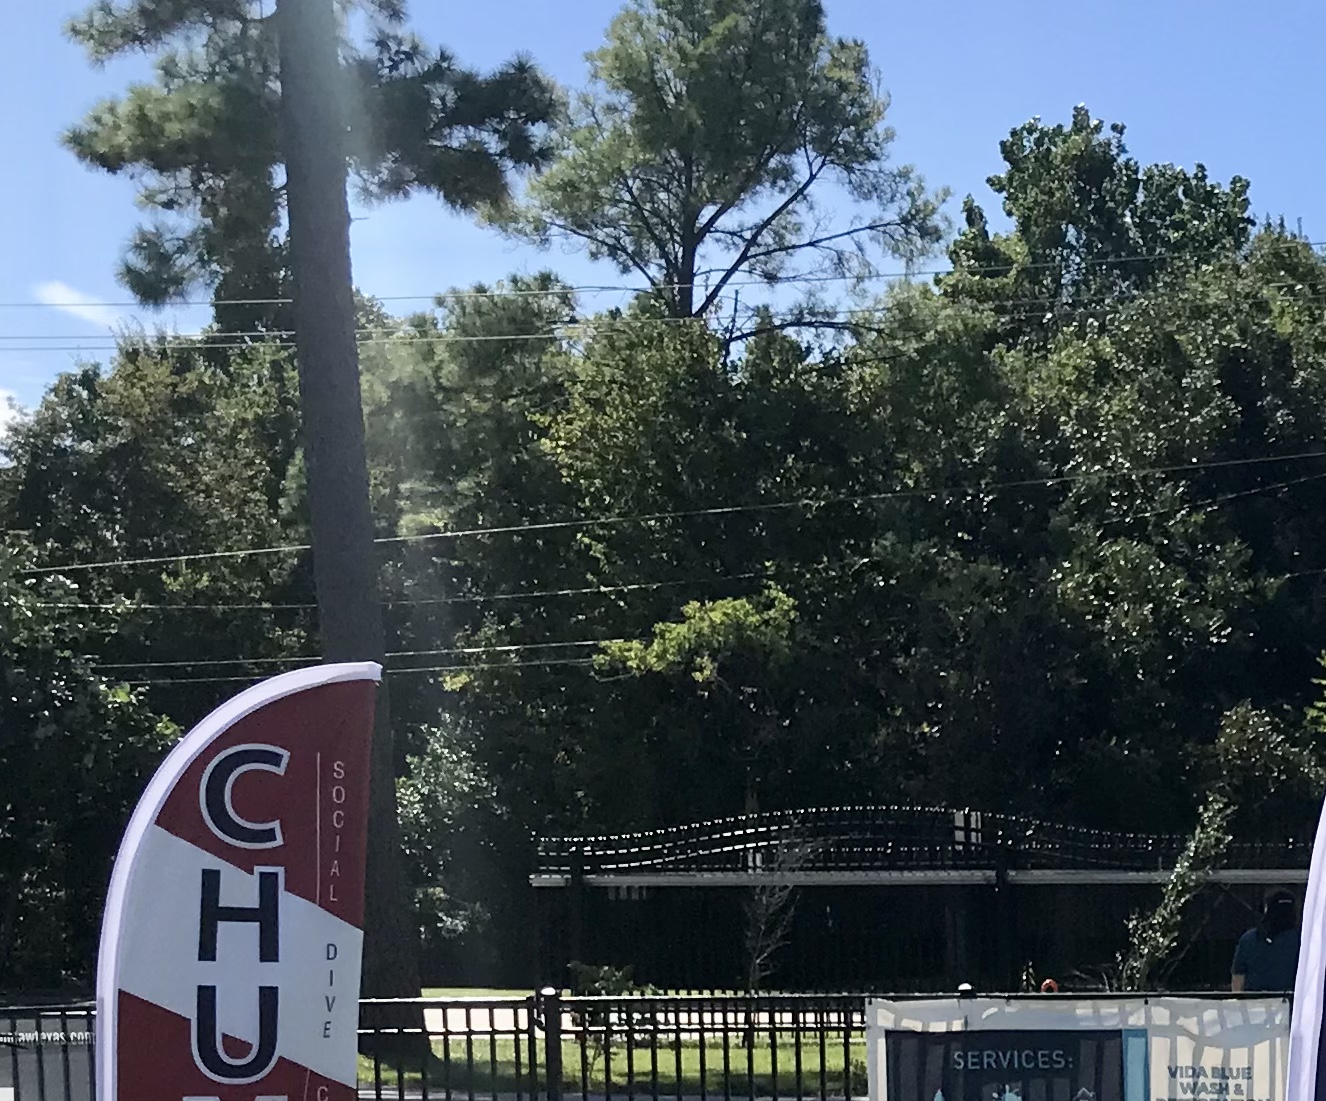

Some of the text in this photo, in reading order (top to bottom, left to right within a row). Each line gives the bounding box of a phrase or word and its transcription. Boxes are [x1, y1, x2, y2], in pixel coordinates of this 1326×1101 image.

[330, 761, 346, 901] SOCIAL
[322, 943, 338, 1039] DIVE
[954, 1050, 1074, 1069] SERVICES:
[1167, 1065, 1252, 1080] VIDA BLUE
[1179, 1081, 1245, 1096] WASH &
